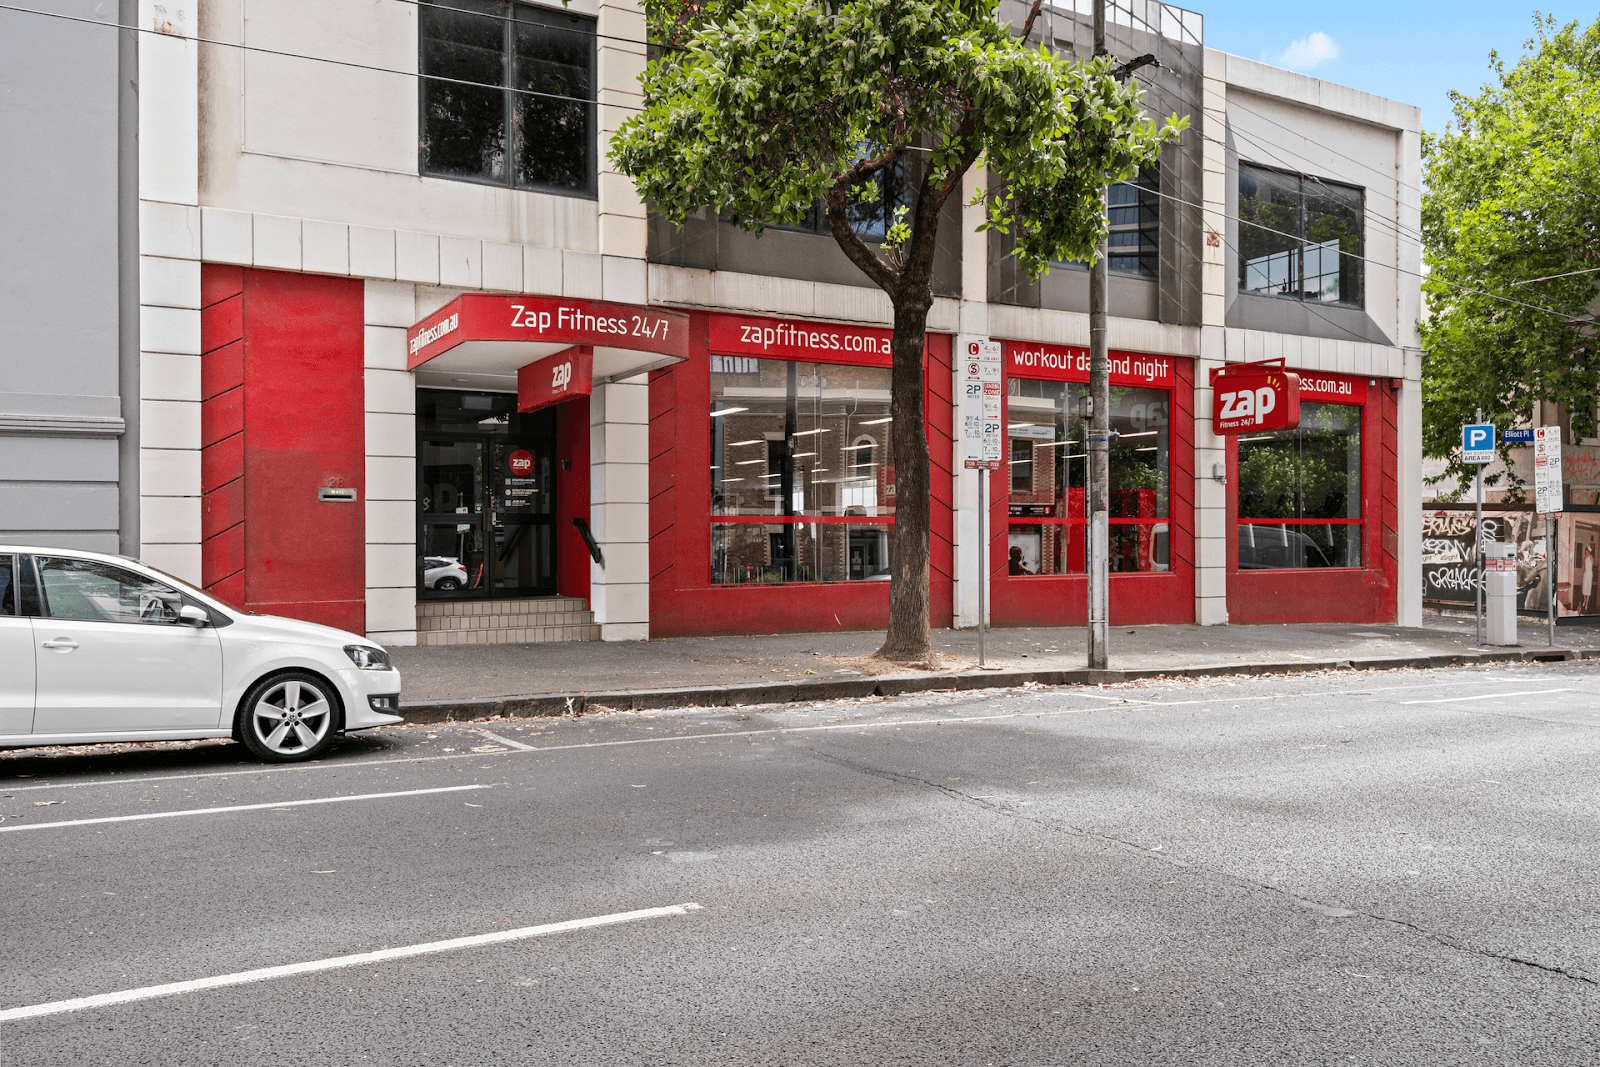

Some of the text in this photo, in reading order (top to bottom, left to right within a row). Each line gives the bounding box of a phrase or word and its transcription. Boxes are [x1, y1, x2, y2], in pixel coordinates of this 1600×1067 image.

[511, 305, 669, 340] Zap Fitness 24/7
[409, 312, 459, 356] zapfitness.com.au
[741, 323, 891, 354] zapfitness.com.a
[1013, 348, 1073, 370] workout
[1077, 352, 1091, 371] da
[1134, 357, 1169, 381] night
[552, 361, 572, 391] zap
[966, 384, 981, 394] 2P
[1220, 386, 1276, 424] zap
[985, 423, 1000, 433] 2P
[1220, 418, 1254, 429] Fitness 24/7
[1470, 429, 1486, 447] P
[1504, 430, 1522, 438] Elliott
[512, 458, 531, 470] zap
[1549, 457, 1560, 466] 2P
[1537, 486, 1547, 495] 2P
